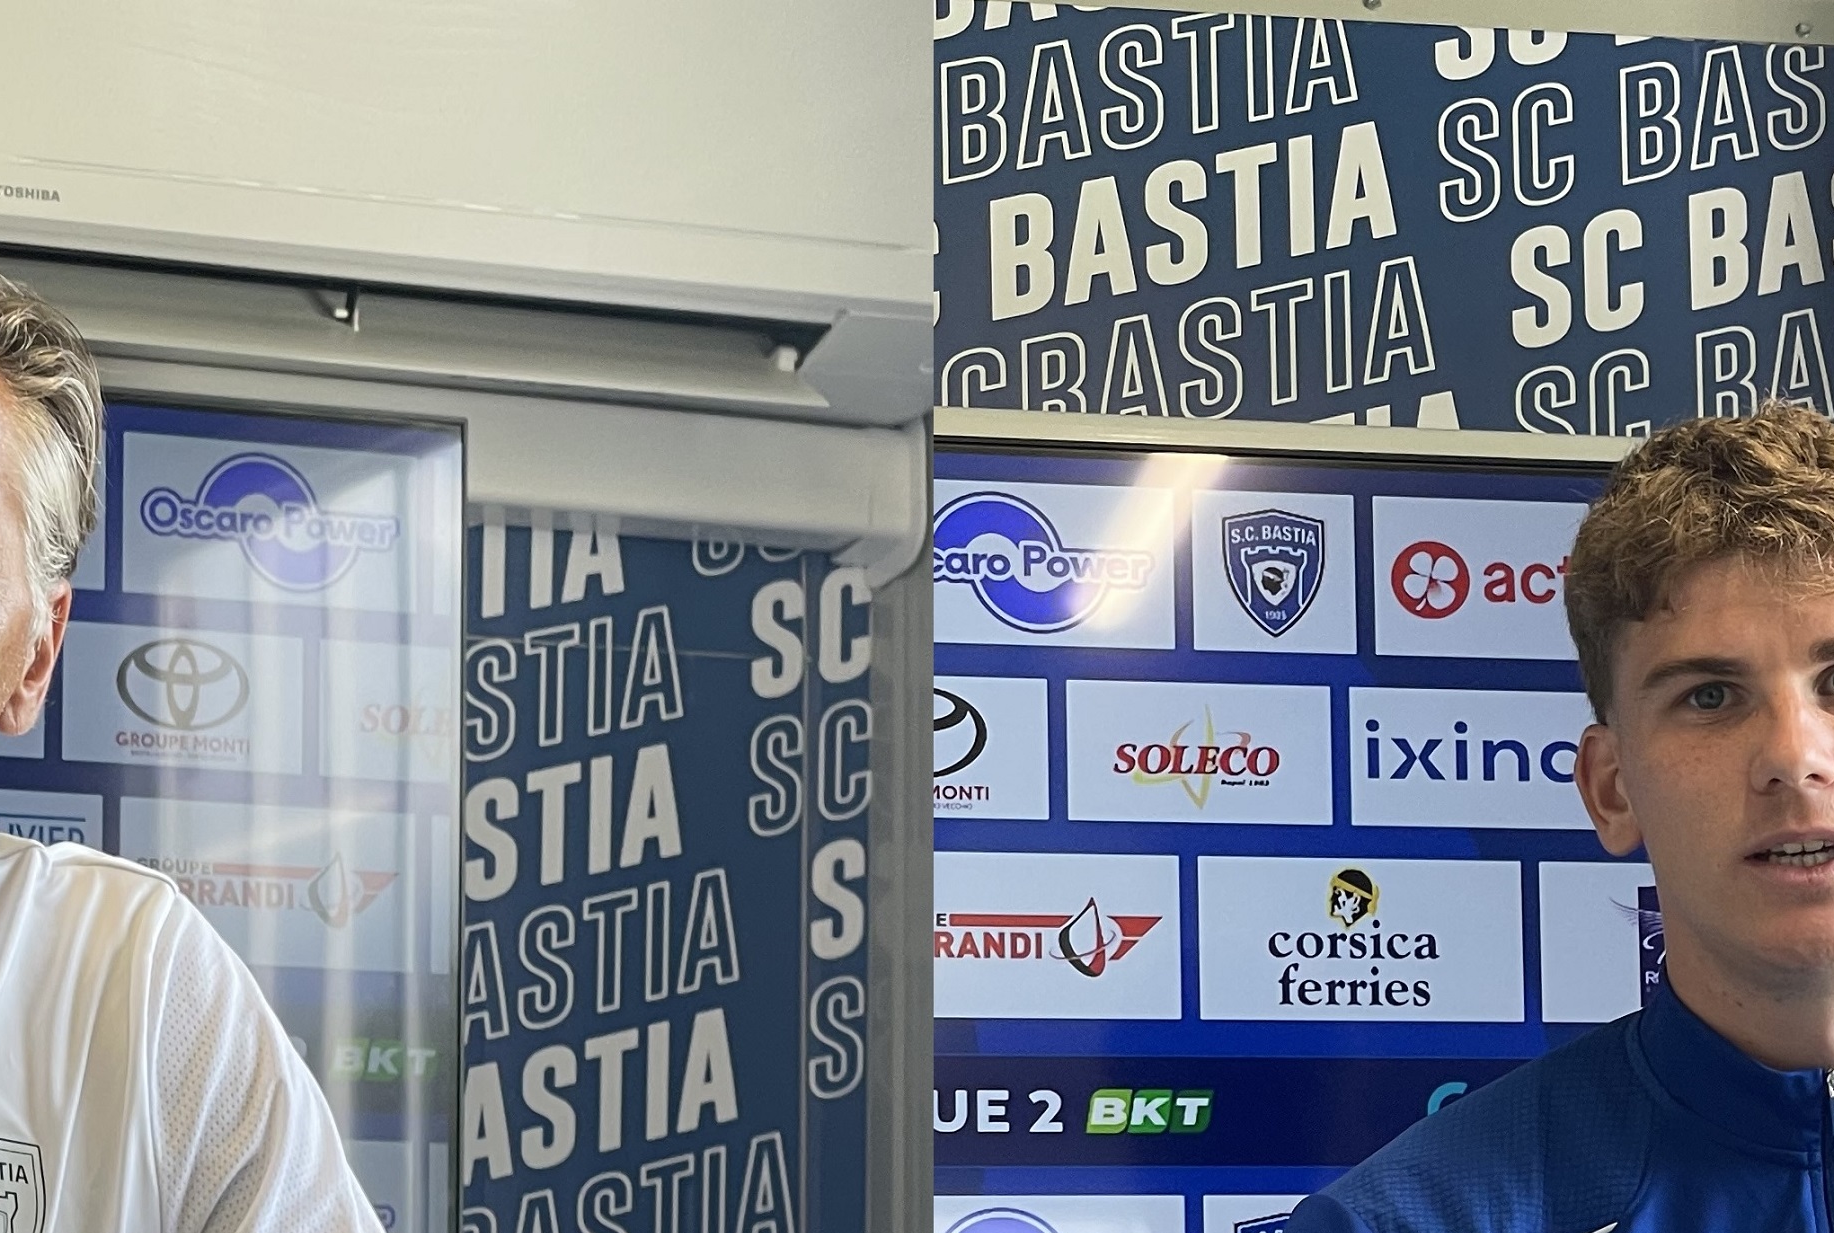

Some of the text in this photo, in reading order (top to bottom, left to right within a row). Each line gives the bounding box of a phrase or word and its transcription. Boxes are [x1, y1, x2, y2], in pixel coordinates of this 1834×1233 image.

[940, 12, 1359, 185] BASTIA
[1438, 82, 1575, 223] SC
[990, 121, 1398, 322] BASTIA
[1510, 209, 1644, 348] SC
[1022, 255, 1436, 420] BASTIA
[148, 495, 397, 546] Oscaro Power
[1231, 525, 1316, 547] S.C. BASTIA
[934, 552, 1011, 577] caro
[465, 566, 872, 761] STIA SC
[115, 731, 250, 755] GROUPE MONTI
[360, 704, 454, 738] SOLE
[1113, 744, 1281, 777] SOLECO
[465, 697, 872, 902] STIA SC
[464, 868, 740, 1045] ASTIA
[934, 931, 1044, 960] RANDI
[1268, 920, 1439, 962] corsica
[1279, 966, 1432, 1008] ferries
[334, 1046, 435, 1076] BKT
[463, 1007, 739, 1187] ASTIA
[1028, 1090, 1064, 1134] 2
[1087, 1097, 1210, 1128] BKT
